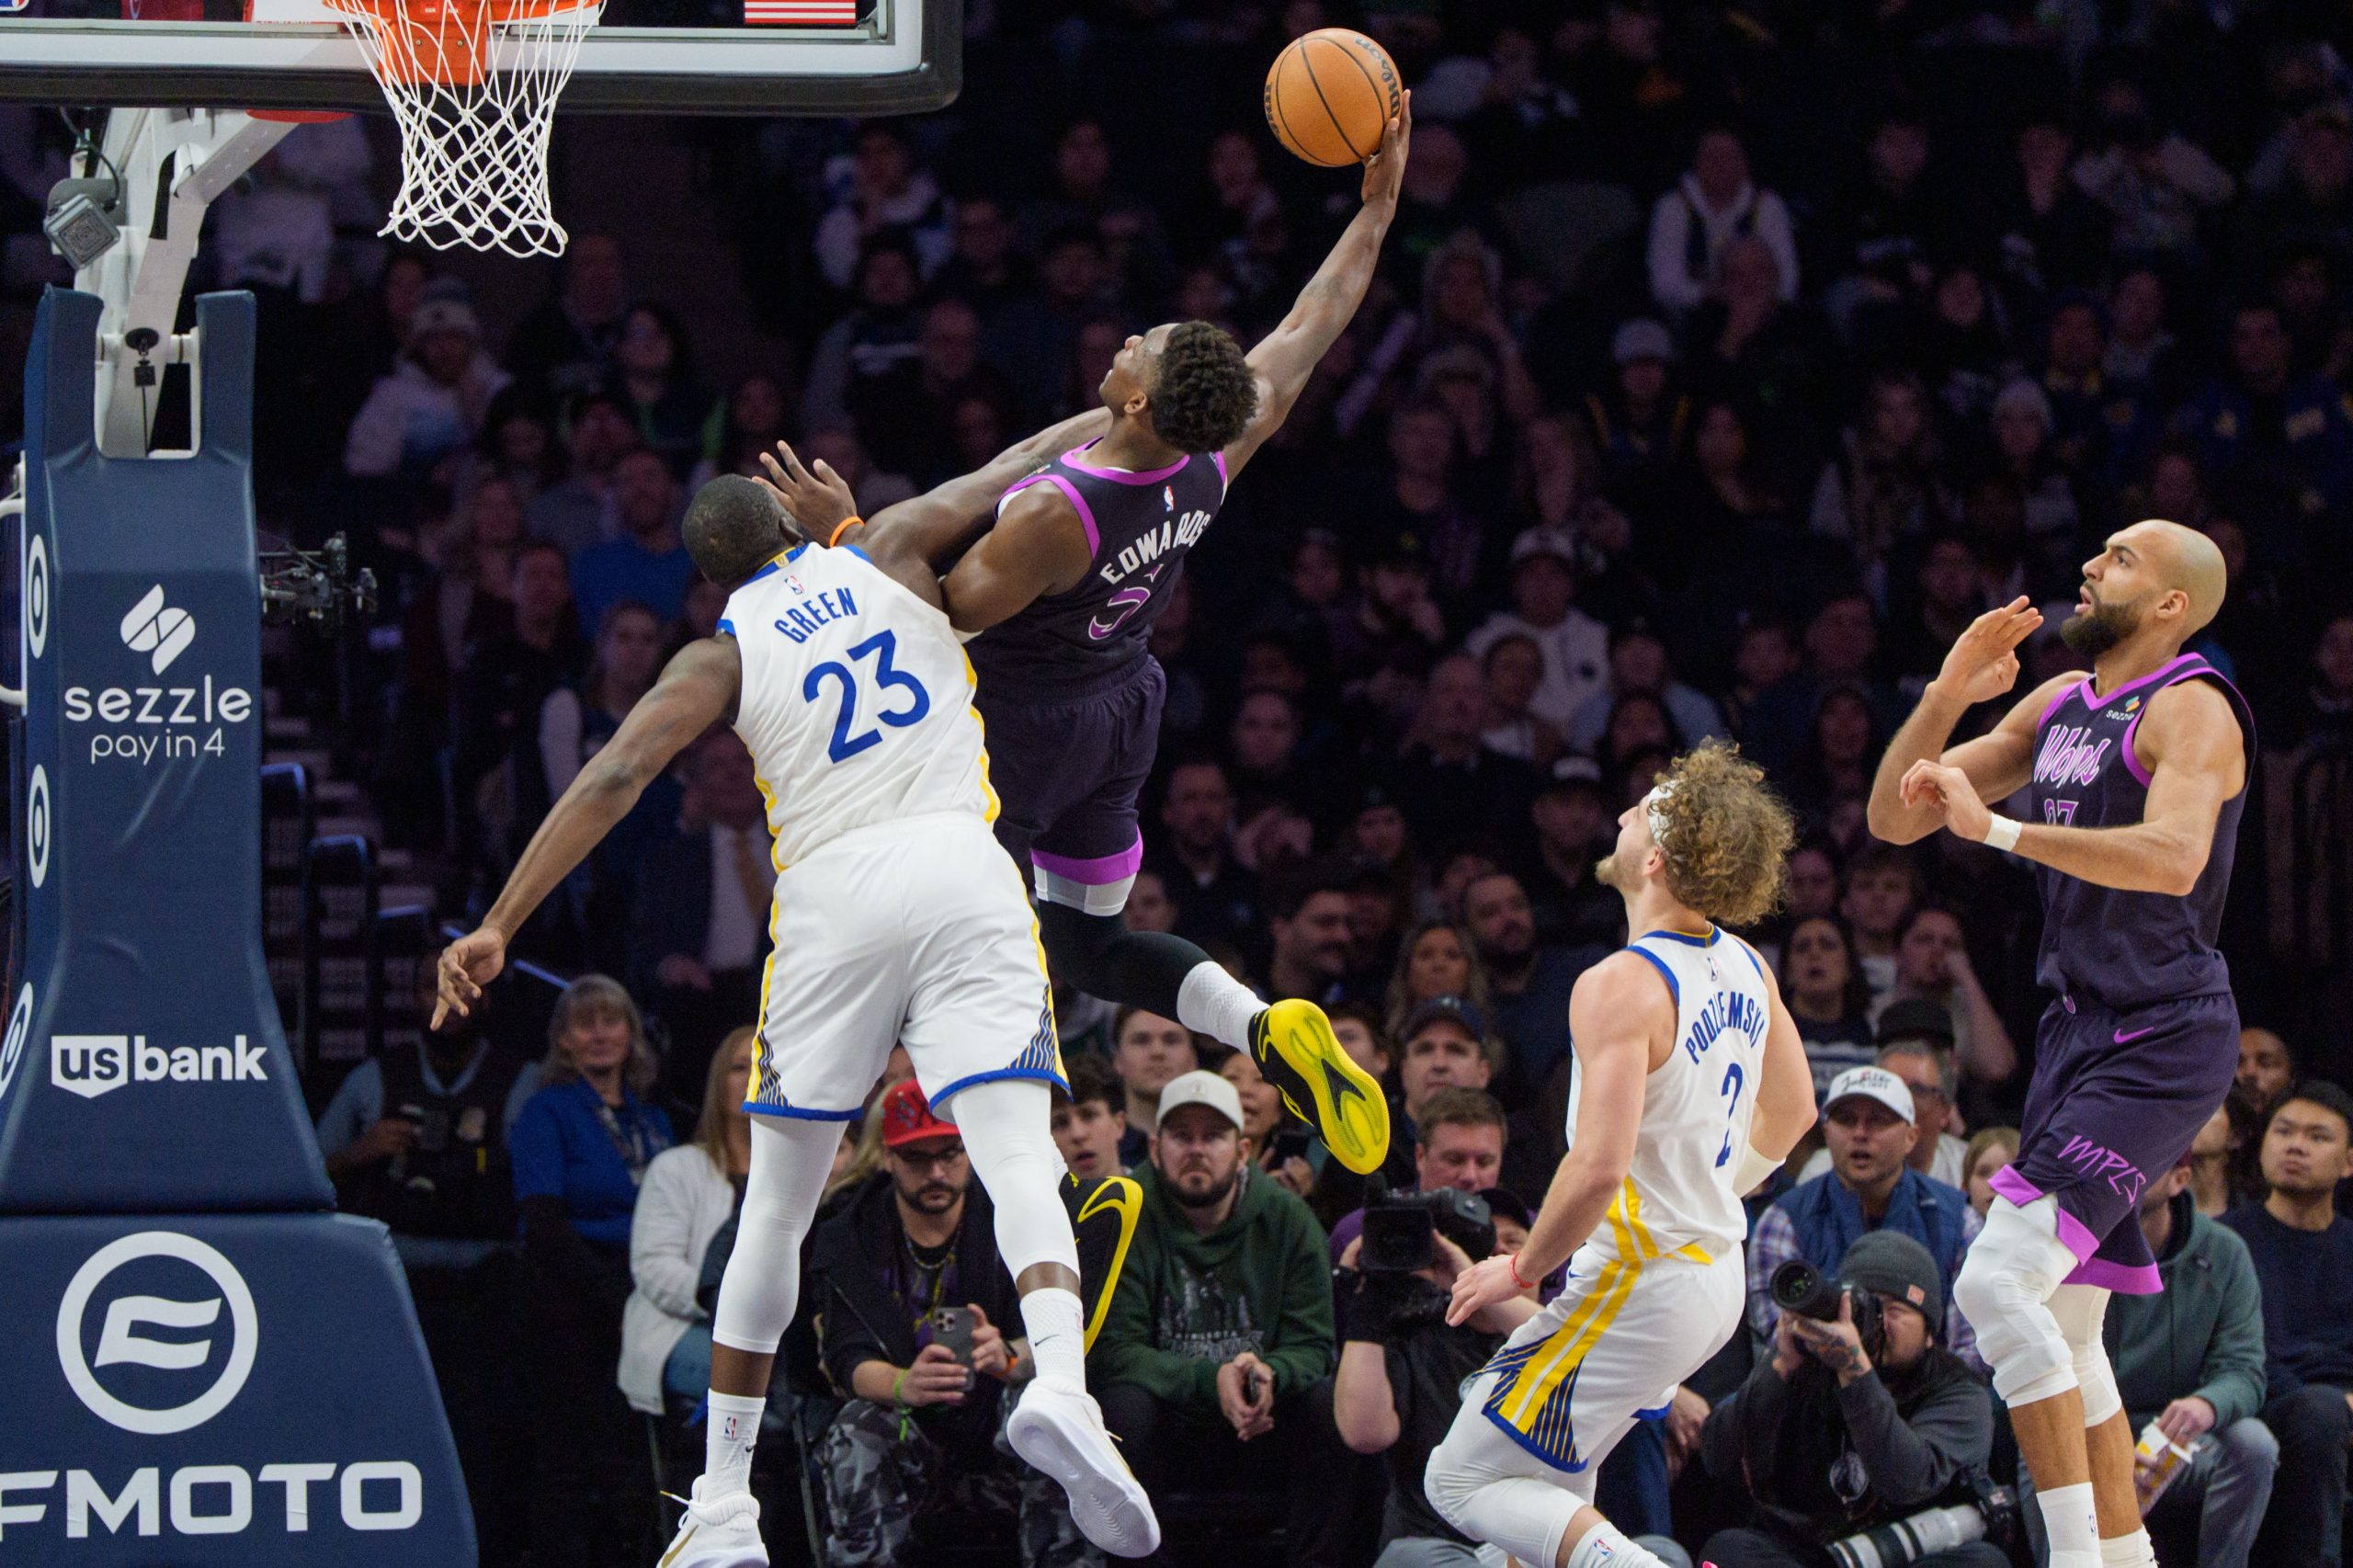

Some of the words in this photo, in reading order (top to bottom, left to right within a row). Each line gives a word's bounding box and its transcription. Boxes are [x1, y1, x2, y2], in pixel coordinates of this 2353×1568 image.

[1099, 510, 1211, 585] EDWARDS
[775, 587, 858, 643] GREEN
[64, 674, 252, 723] sezzle
[803, 629, 930, 764] 23
[91, 734, 158, 767] pay
[165, 727, 197, 758] in
[203, 727, 225, 758] 4
[1715, 1062, 1743, 1168] 2
[2057, 1134, 2147, 1209] MPLS
